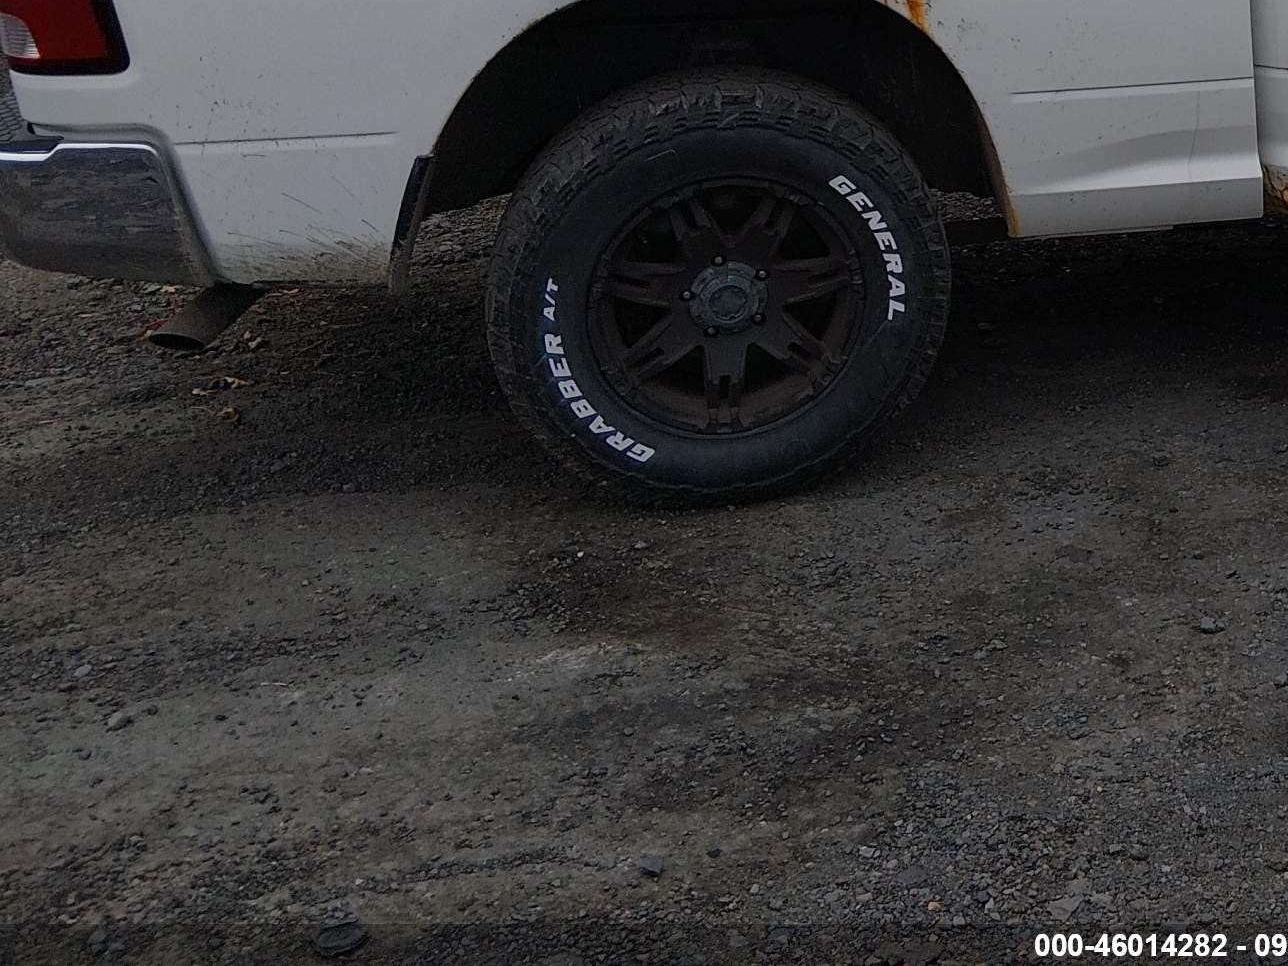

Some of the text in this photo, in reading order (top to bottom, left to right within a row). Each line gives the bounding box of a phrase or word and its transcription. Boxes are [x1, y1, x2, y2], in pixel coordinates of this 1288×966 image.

[829, 175, 906, 321] GENERAL
[543, 278, 656, 463] GRABBER A/T
